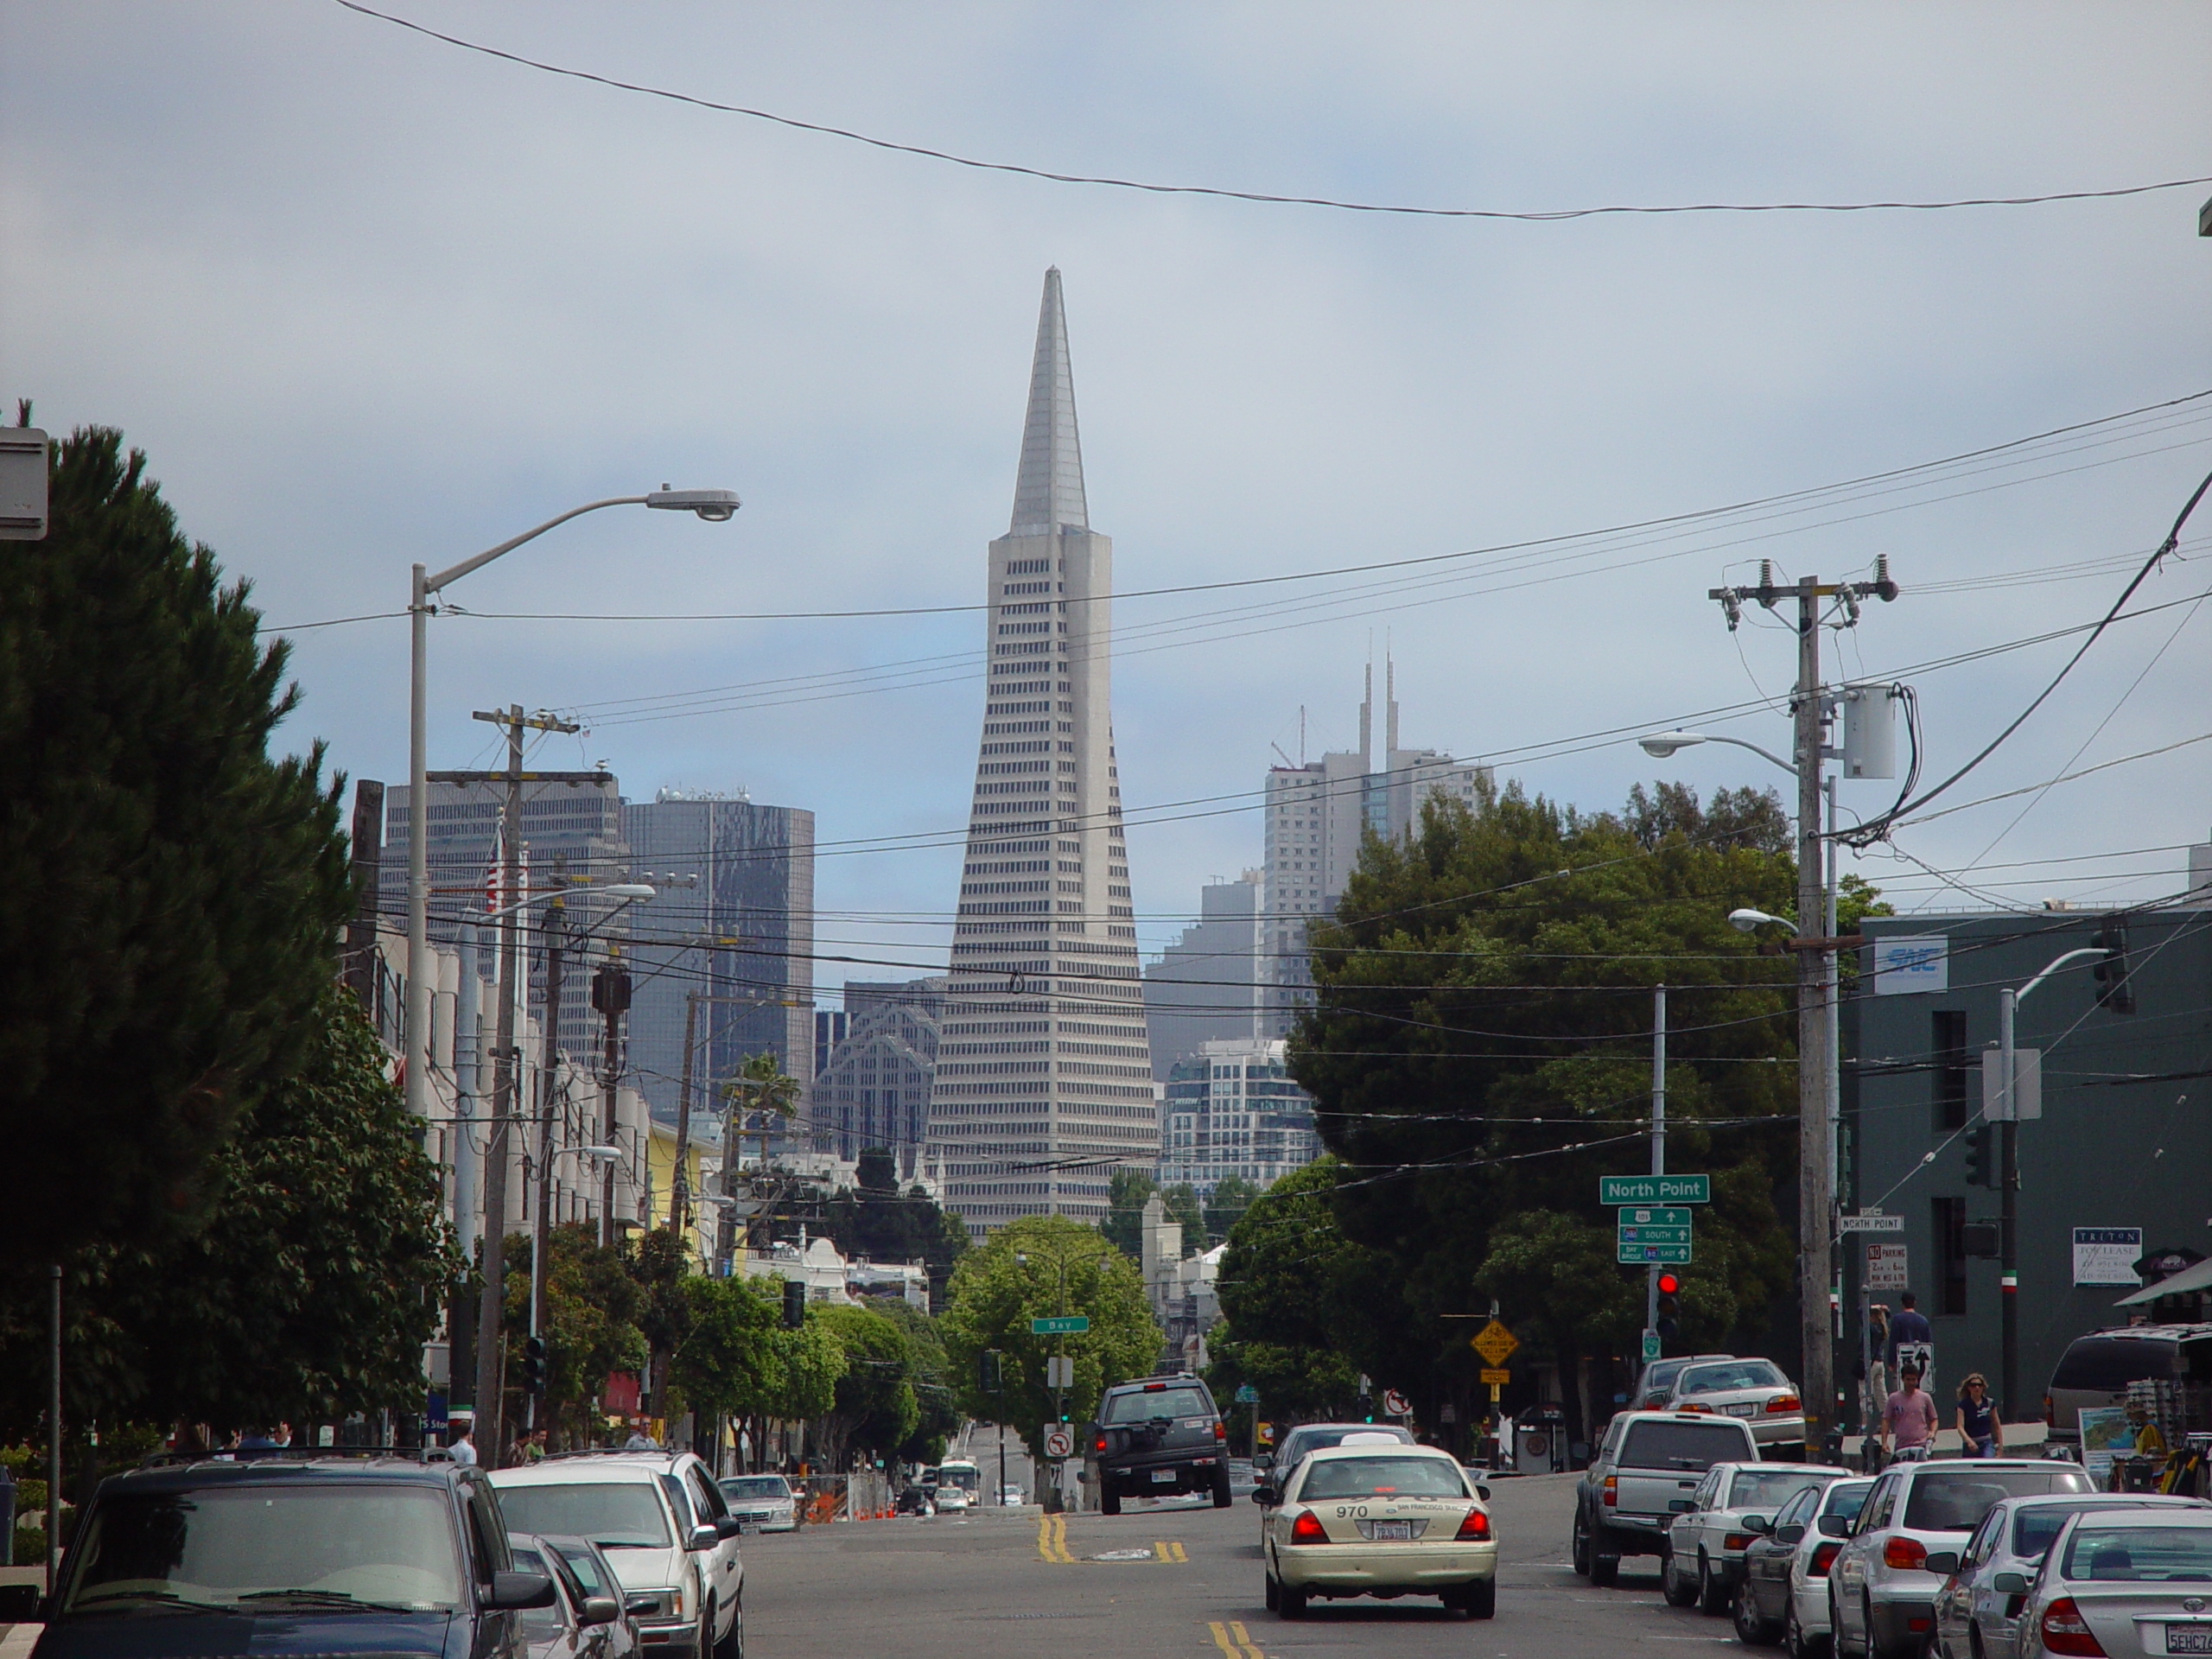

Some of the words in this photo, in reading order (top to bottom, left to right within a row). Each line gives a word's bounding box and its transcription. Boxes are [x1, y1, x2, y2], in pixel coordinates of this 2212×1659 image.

[1609, 1183, 1654, 1198] North
[1660, 1181, 1700, 1196] Point
[1843, 1219, 1870, 1229] NORTH
[1874, 1219, 1897, 1229] POINT
[1645, 1230, 1671, 1239] SOUTH
[2080, 1232, 2135, 1242] TRITON
[1869, 1246, 1880, 1259] NO
[1882, 1249, 1905, 1257] PARKING
[1049, 1321, 1071, 1330] Bay
[1336, 1506, 1368, 1518] 970
